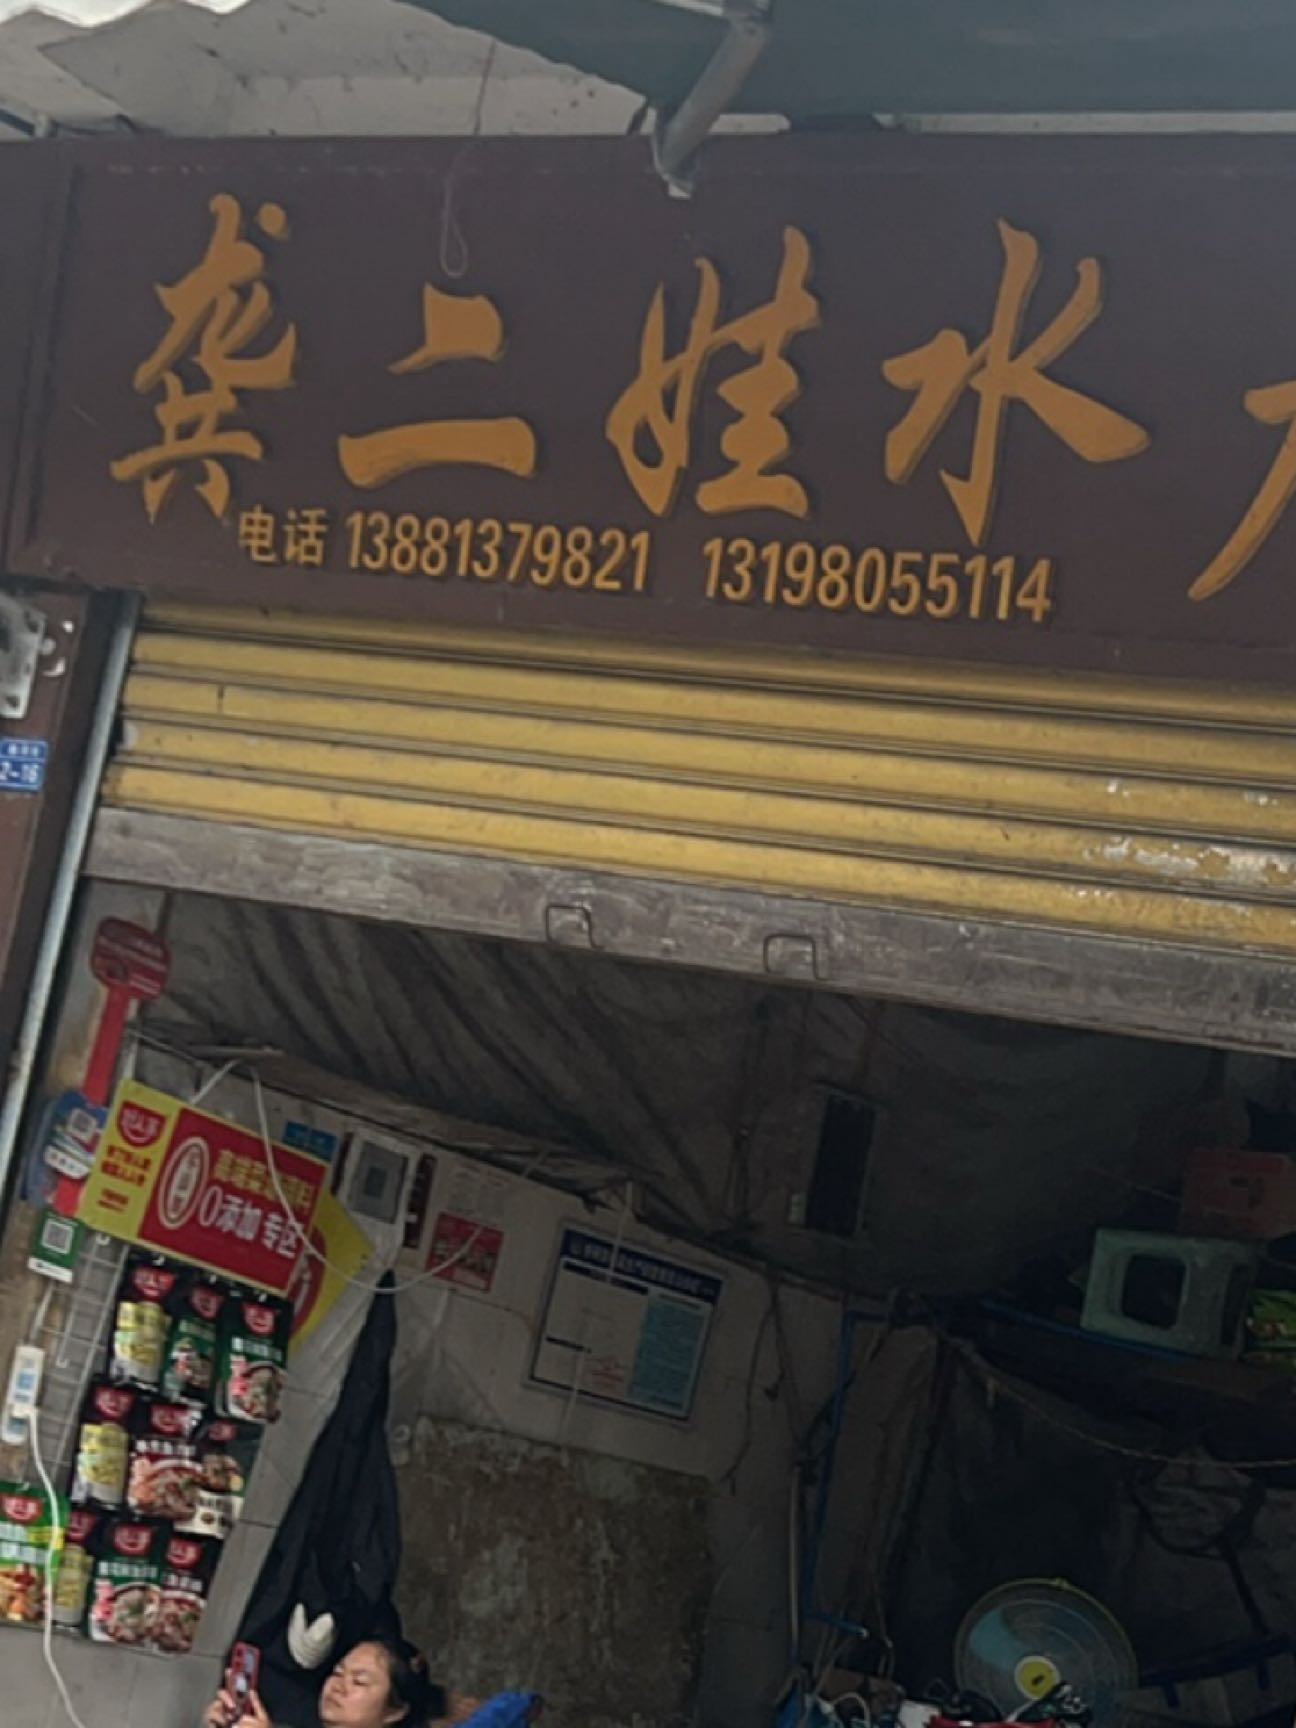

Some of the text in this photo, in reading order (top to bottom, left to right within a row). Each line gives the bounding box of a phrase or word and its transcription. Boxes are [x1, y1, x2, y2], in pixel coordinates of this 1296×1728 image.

[239, 504, 1053, 623] 电话 13881379821 13198055114
